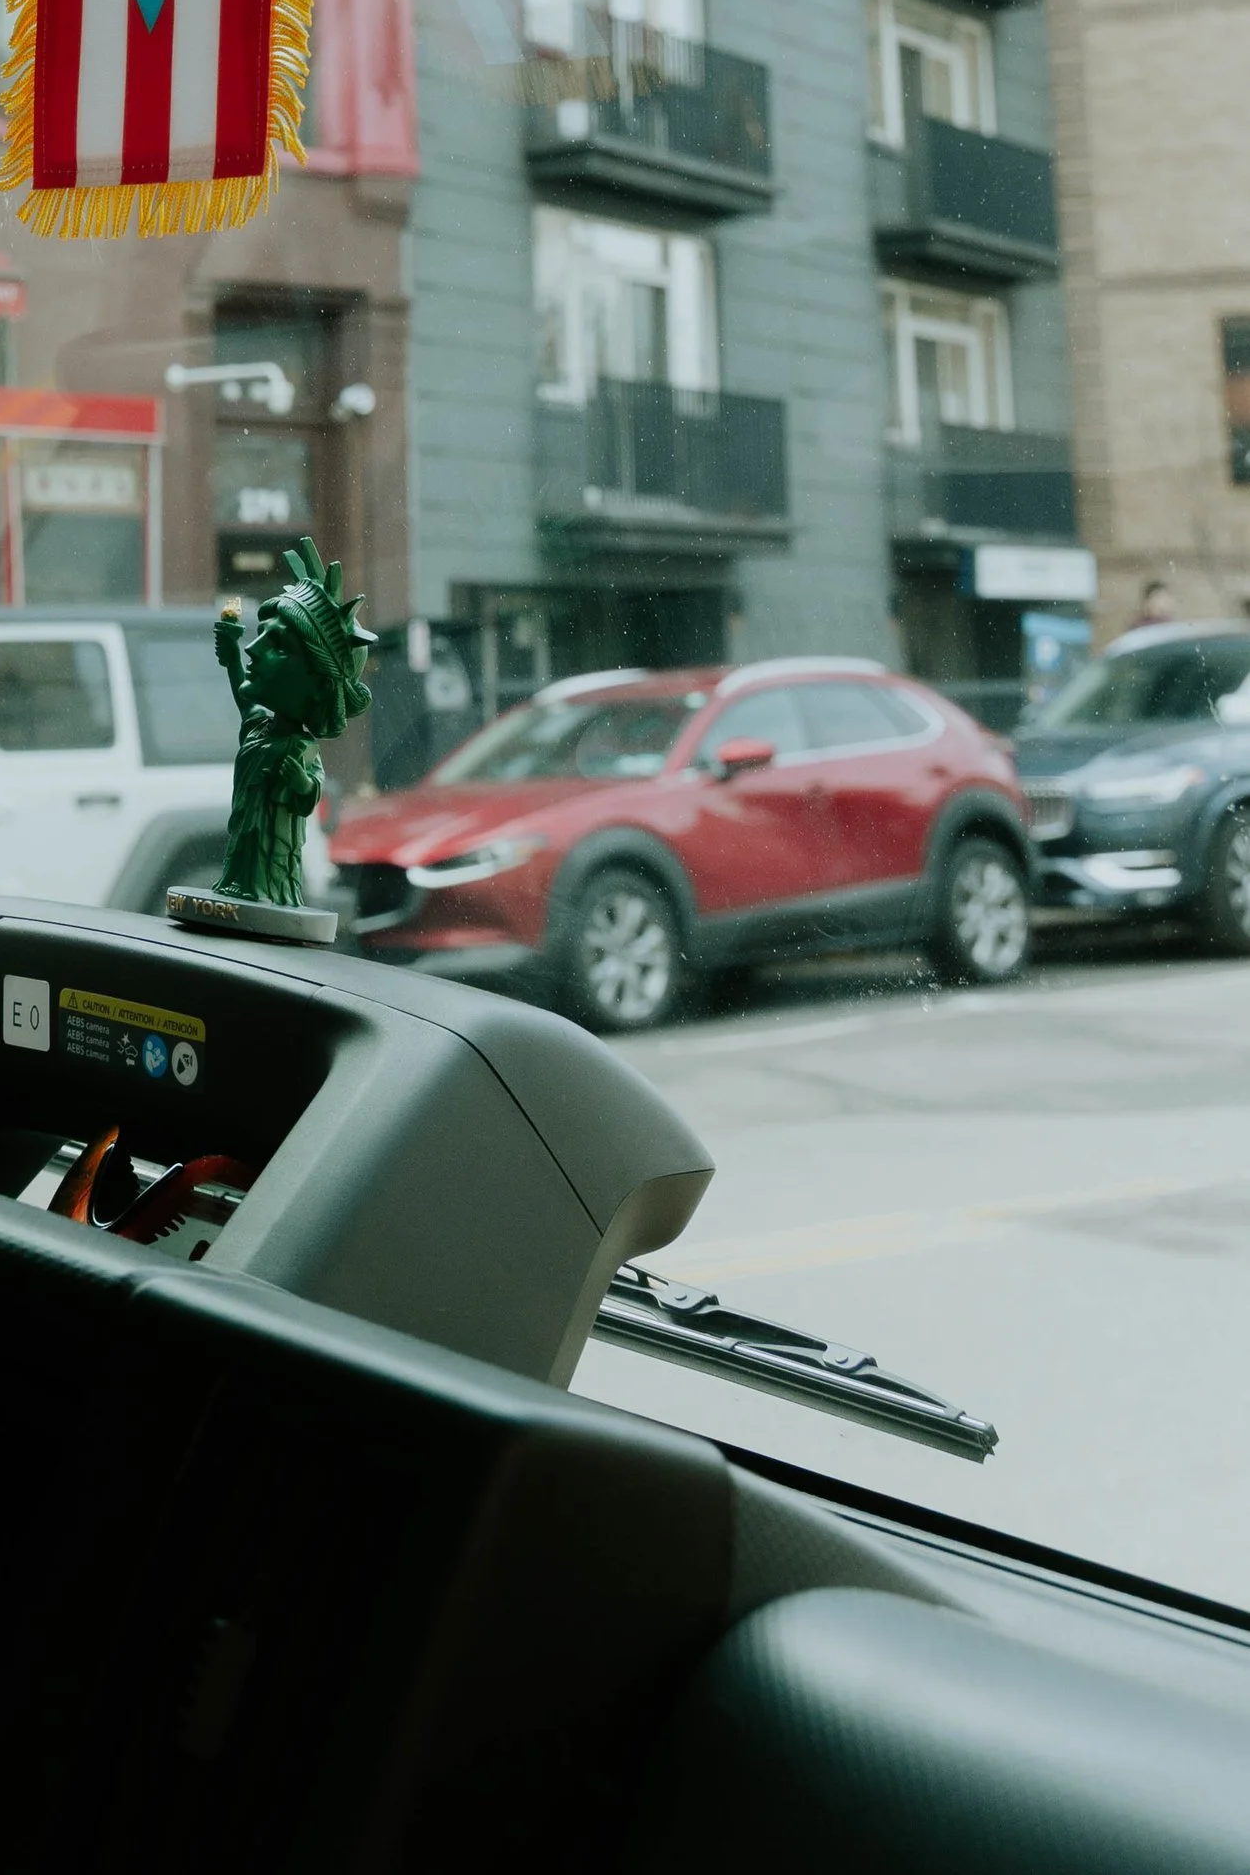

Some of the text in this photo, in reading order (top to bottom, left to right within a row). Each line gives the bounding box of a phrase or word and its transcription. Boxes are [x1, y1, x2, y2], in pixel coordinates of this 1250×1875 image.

[192, 898, 241, 921] YORK
[67, 1015, 110, 1036] AEBS camera
[82, 999, 110, 1015] CAUTION
[118, 1009, 154, 1025] ATTENTION
[163, 1020, 199, 1036] ATENCIÓN
[67, 1029, 86, 1042] AEBS
[67, 1042, 86, 1056] AEBS
